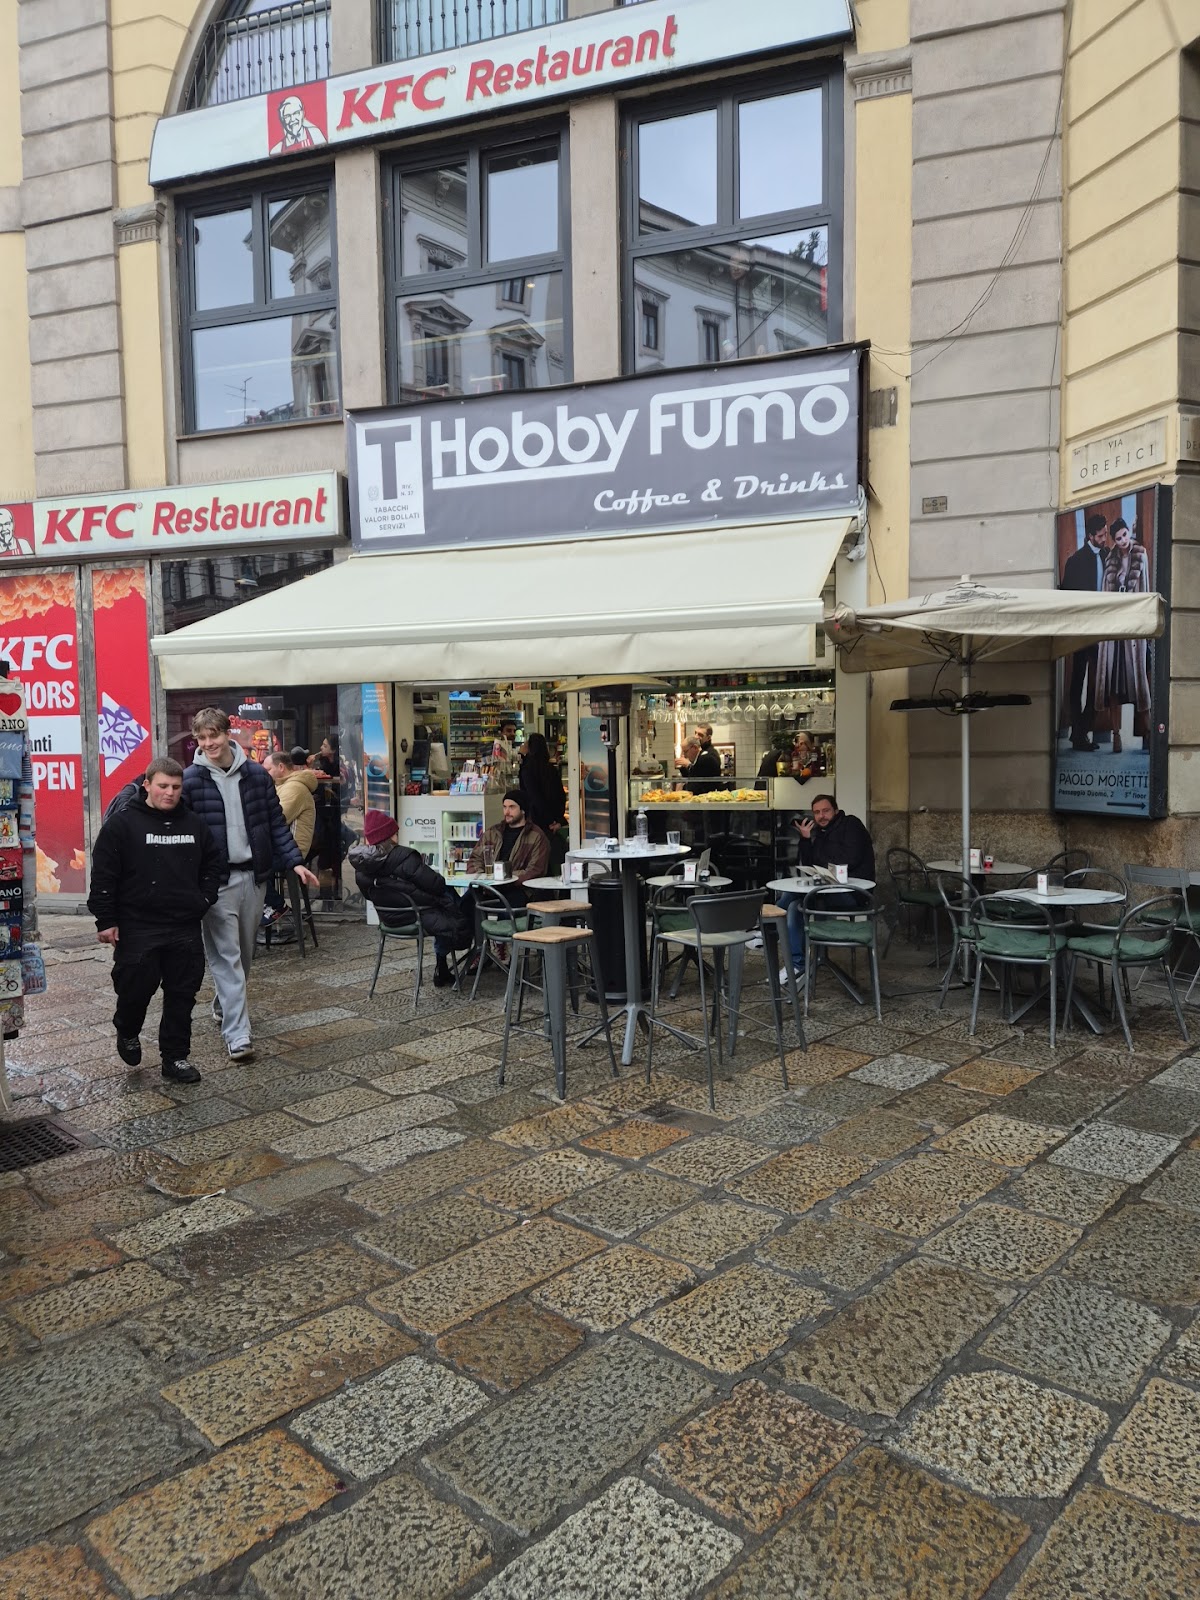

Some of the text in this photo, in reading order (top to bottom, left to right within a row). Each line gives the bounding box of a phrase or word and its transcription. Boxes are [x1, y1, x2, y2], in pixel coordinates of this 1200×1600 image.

[465, 14, 678, 101] Restaurant
[430, 405, 639, 489] Hobby
[1108, 438, 1123, 449] VIA
[1080, 444, 1154, 479] OREFICI
[593, 471, 849, 515] Coffee & Drinks
[152, 487, 327, 536] Restaurant
[374, 505, 408, 513] TABACCHI
[364, 513, 420, 523] VALORI BOLLATI
[379, 523, 405, 531] SERVIZI
[0, 718, 25, 730] ANO
[33, 761, 76, 790] PEN
[1059, 773, 1149, 788] PAOLO MORETTI
[1058, 789, 1086, 797] Passaggio
[414, 818, 436, 826] IQOS
[146, 833, 195, 845] BALENCIAGA
[0, 887, 22, 897] ANO
